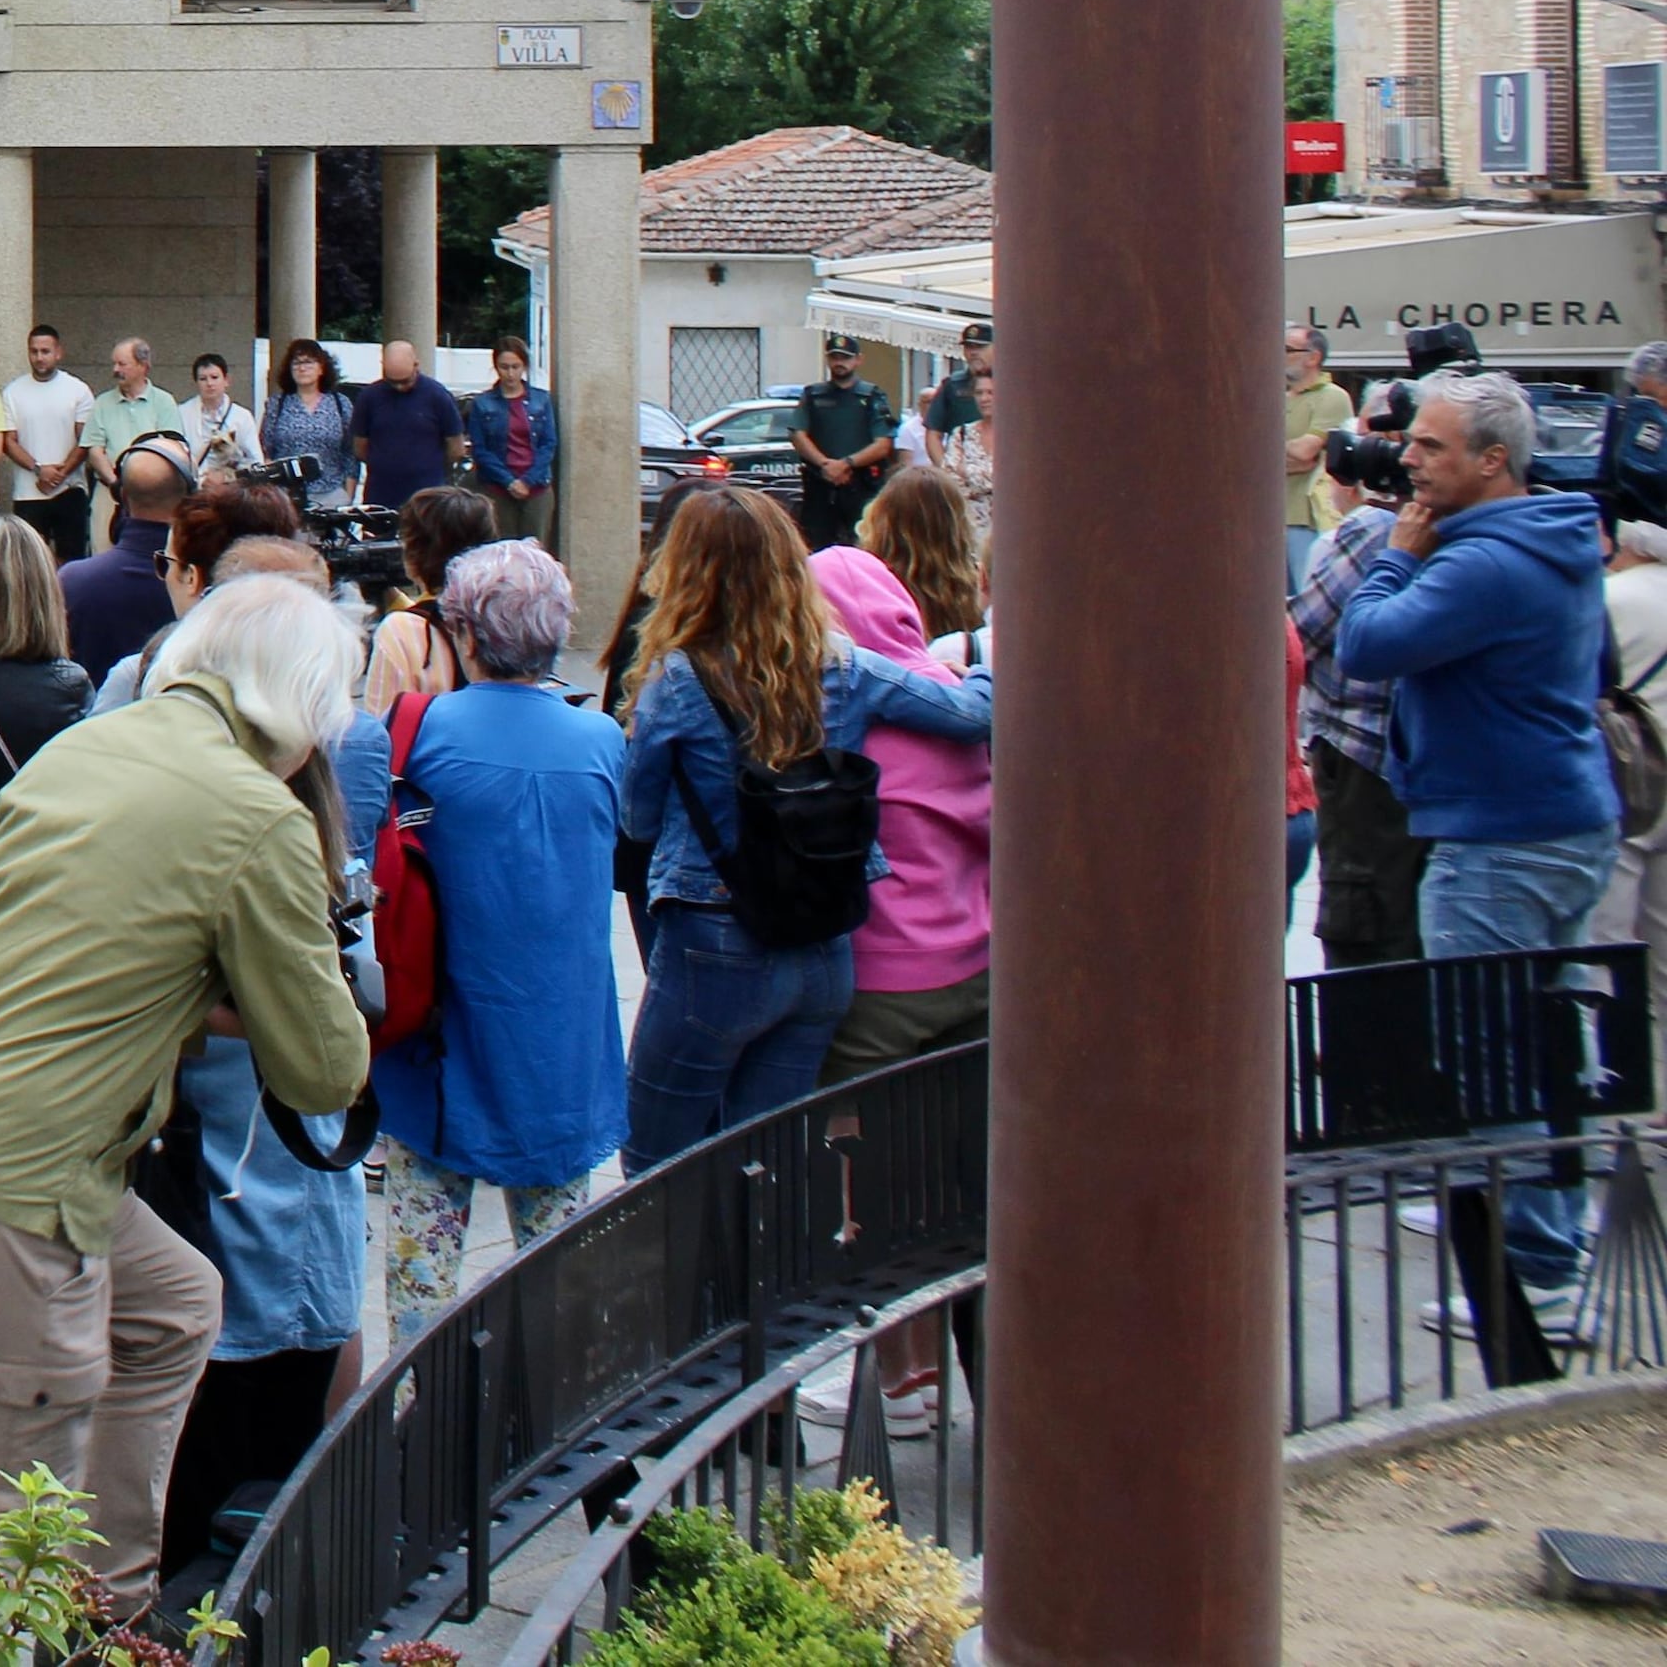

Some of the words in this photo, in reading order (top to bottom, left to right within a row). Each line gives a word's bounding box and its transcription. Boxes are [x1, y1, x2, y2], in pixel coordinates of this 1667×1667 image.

[511, 47, 569, 63] VILLA
[1308, 304, 1361, 330] LA
[1397, 301, 1622, 329] CHOPERA
